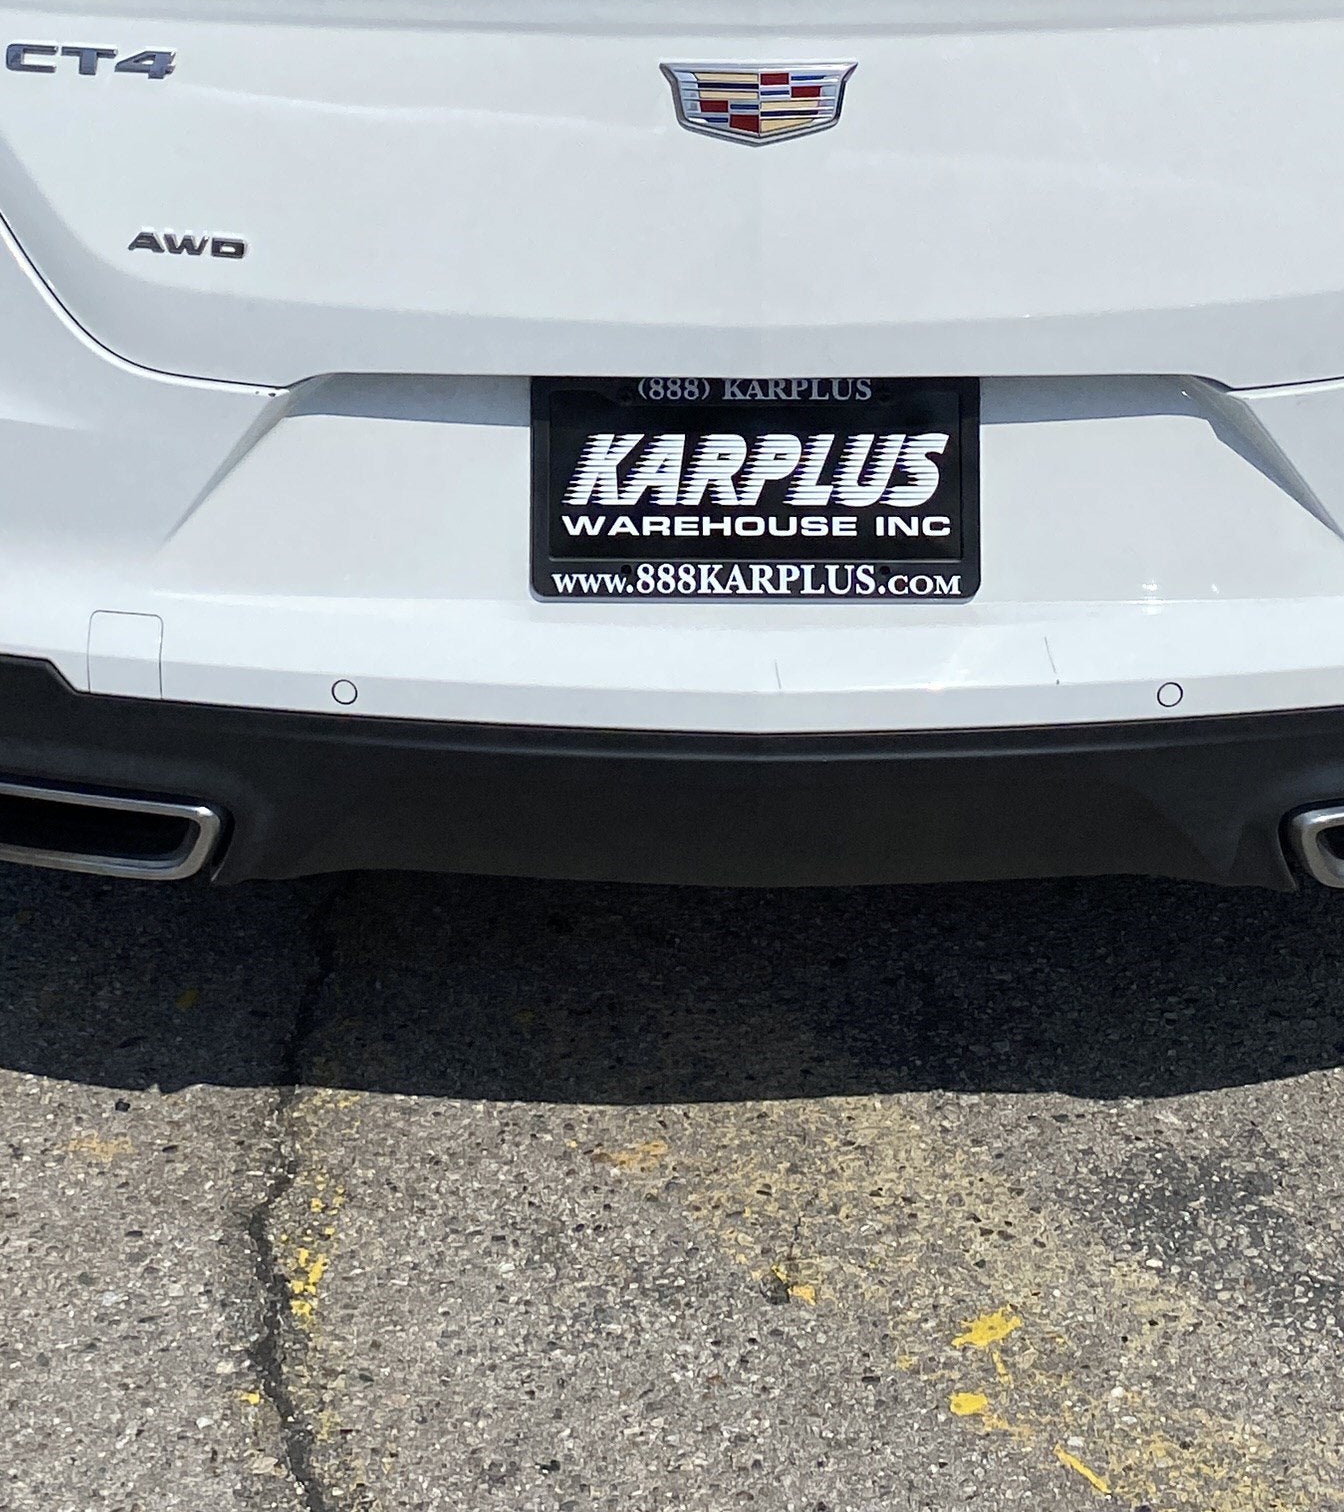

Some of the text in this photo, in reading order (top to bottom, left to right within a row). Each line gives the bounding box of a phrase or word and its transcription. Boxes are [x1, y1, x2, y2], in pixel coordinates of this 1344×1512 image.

[6, 42, 177, 80] CT4
[128, 228, 248, 260] AWD
[637, 378, 873, 402] (888) KARPLUS
[560, 432, 950, 508] KARPLUS
[561, 515, 952, 537] WAREHOUSE INC
